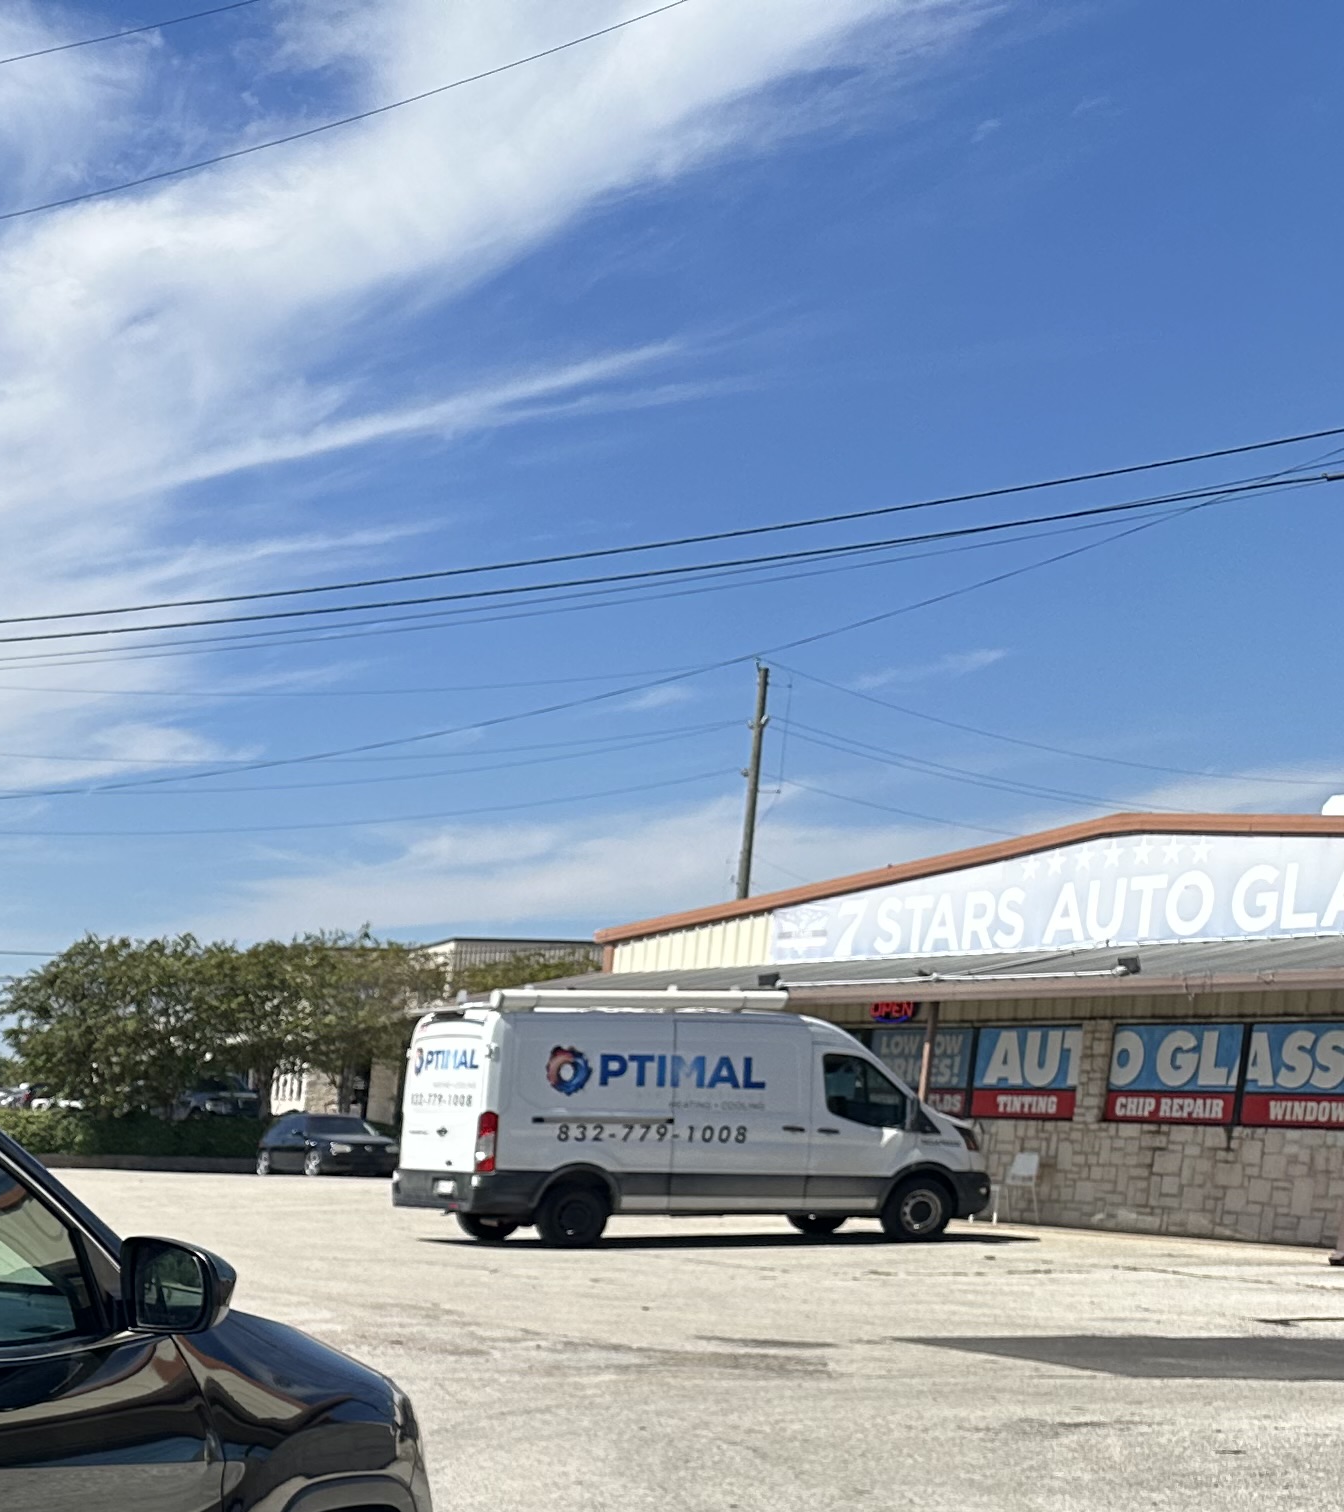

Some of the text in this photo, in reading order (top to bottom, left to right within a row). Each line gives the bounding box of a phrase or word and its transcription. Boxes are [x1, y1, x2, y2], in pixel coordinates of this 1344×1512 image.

[835, 899, 869, 957] 7
[873, 887, 1027, 954] STARS
[1043, 869, 1216, 945] AUTO
[869, 1001, 914, 1018] OPEN
[880, 1033, 964, 1056] LOW OW
[882, 1055, 962, 1085] RIES!
[1156, 1029, 1344, 1089] GLASS
[996, 1095, 1058, 1115] TINTING
[1114, 1096, 1224, 1119] CHIP REPAIR
[556, 1124, 748, 1144] 832-779-1008
